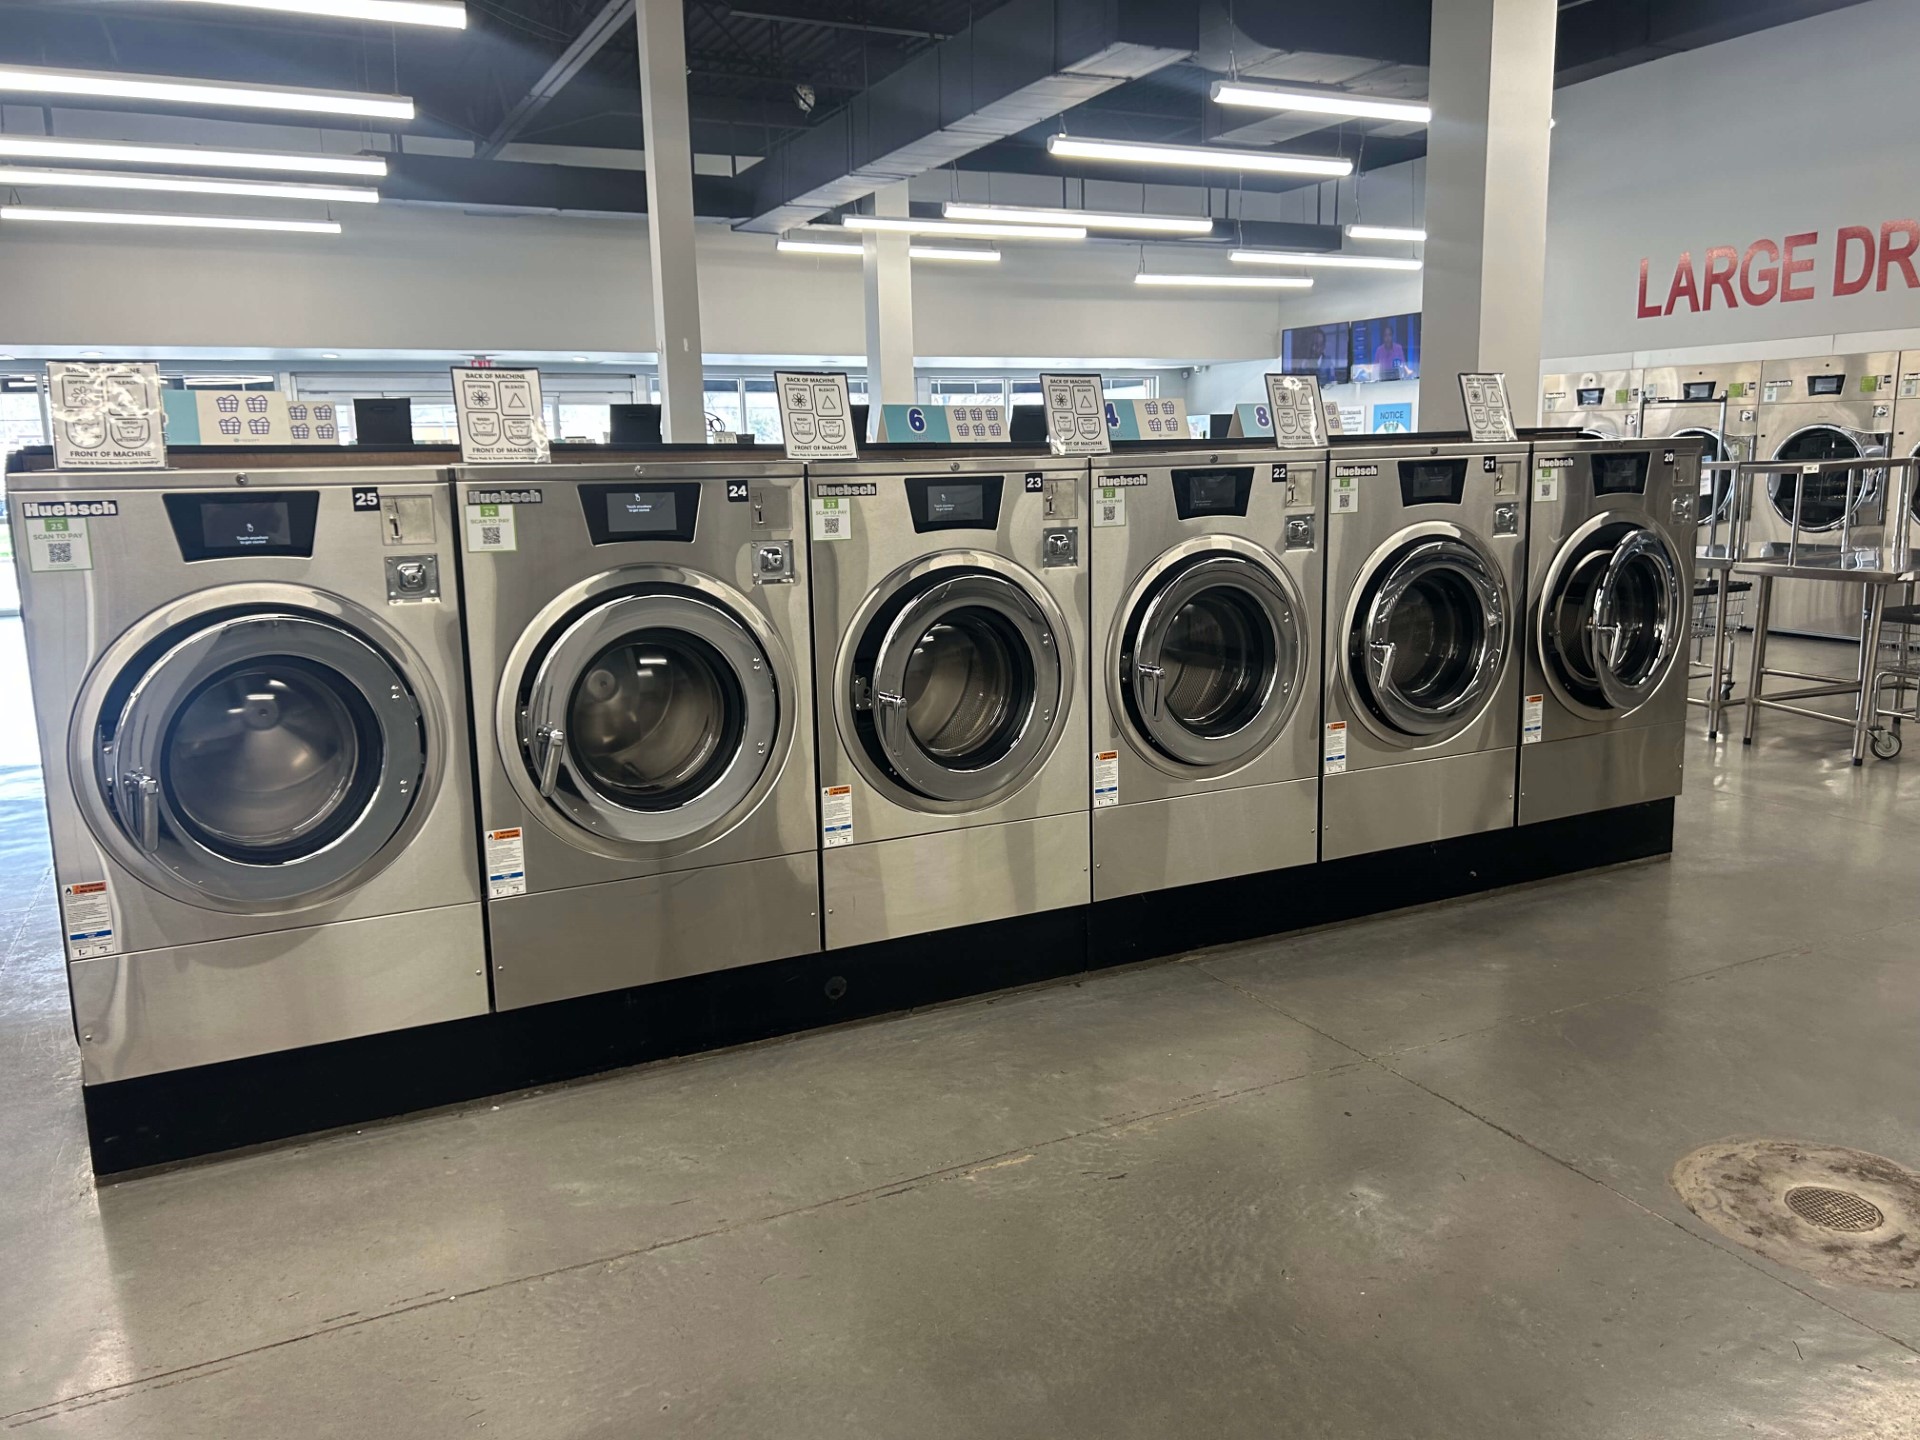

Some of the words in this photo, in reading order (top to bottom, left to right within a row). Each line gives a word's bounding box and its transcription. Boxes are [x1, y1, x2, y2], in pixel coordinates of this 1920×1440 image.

[1637, 232, 1818, 318] LARGE
[908, 407, 926, 433] 6
[1255, 405, 1270, 428] 8
[1380, 411, 1404, 419] NOTICE
[1540, 458, 1574, 467] Huebsch
[1664, 453, 1674, 461] 20
[1484, 460, 1494, 469] 21
[1273, 468, 1286, 478] 22
[1336, 466, 1377, 476] Huebsch
[1027, 478, 1041, 488] 23
[1099, 475, 1146, 486] Huebsch
[729, 485, 747, 497] 24
[818, 484, 876, 496] Huebsch
[355, 493, 378, 506] 25
[469, 490, 541, 503] Huebsch
[24, 501, 116, 516] Huebsch
